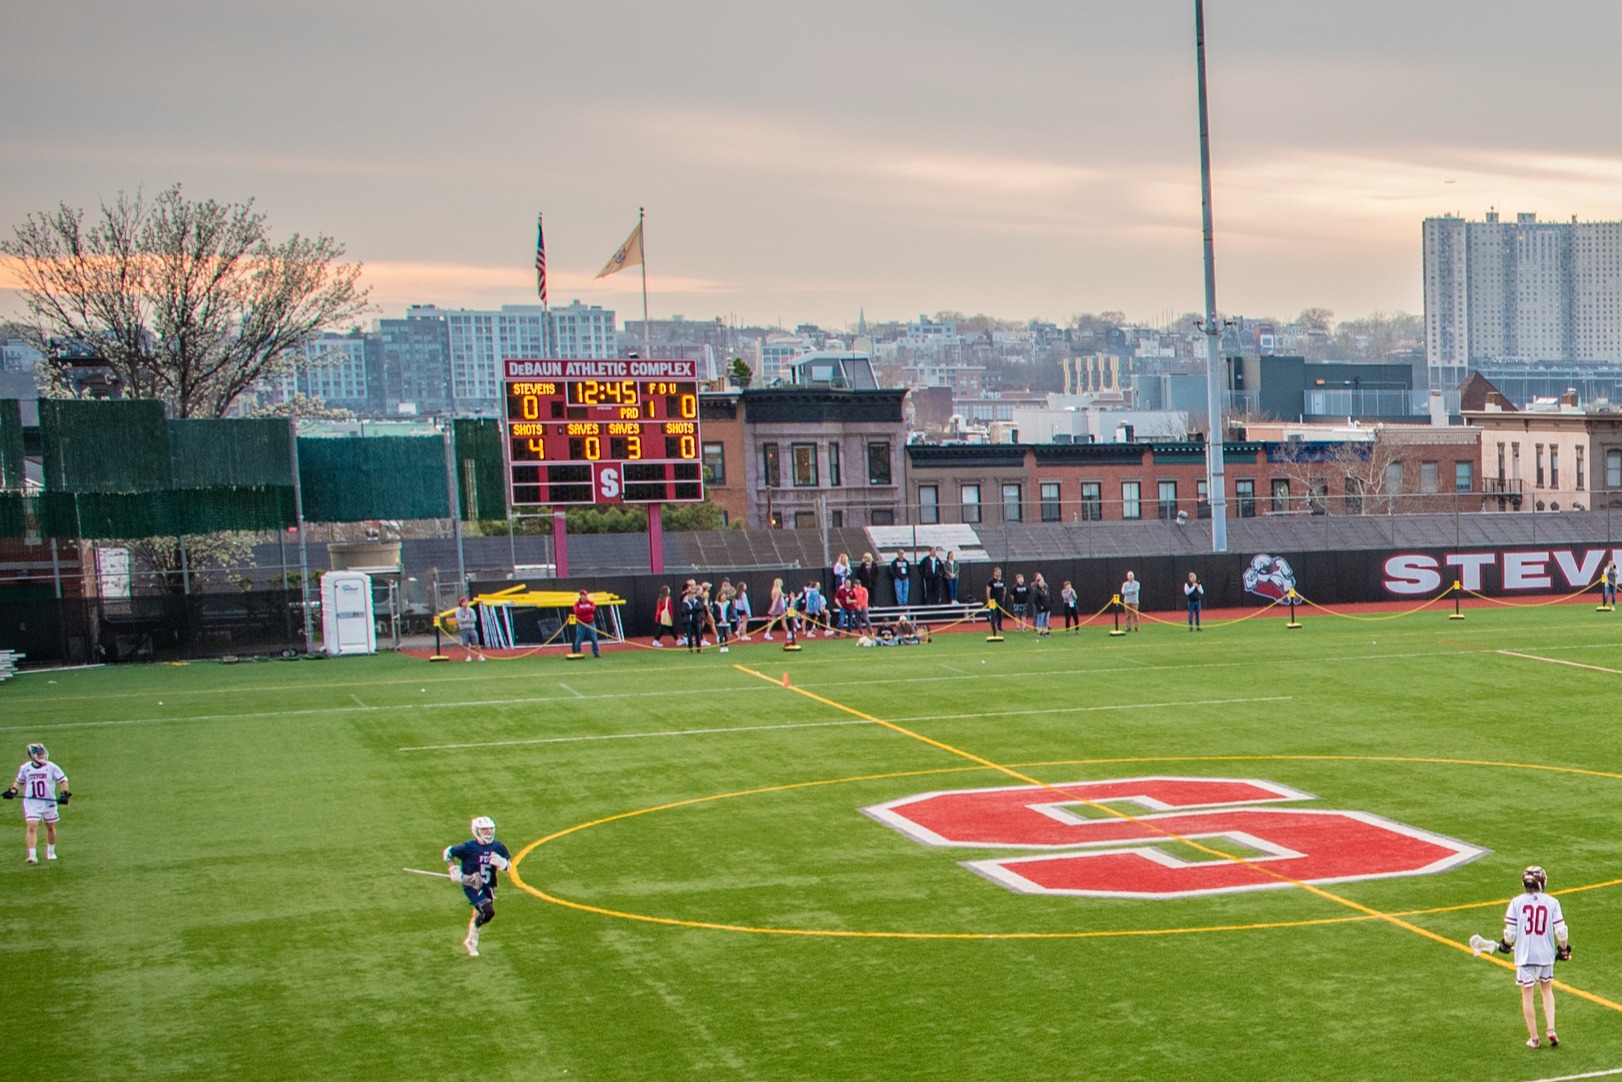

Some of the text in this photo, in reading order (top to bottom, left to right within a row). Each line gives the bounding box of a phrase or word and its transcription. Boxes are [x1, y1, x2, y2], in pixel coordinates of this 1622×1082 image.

[566, 362, 628, 376] ATHLETIC
[630, 362, 692, 376] COMPLEX
[514, 384, 556, 395] STEVENS
[577, 380, 637, 404] 12:45
[523, 396, 538, 420] 0
[620, 407, 638, 419] PRD
[649, 400, 655, 418] 1
[682, 394, 696, 418] 0
[514, 423, 542, 435] SHOTS
[568, 423, 599, 435] SAVES
[609, 423, 640, 434] SAVES
[666, 422, 694, 434] SHOTS
[528, 438, 544, 460] 4
[585, 436, 600, 460] 0
[628, 436, 641, 460] 3
[681, 436, 696, 459] 0
[600, 468, 619, 498] S
[32, 781, 45, 798] 10
[858, 776, 1494, 900] S
[480, 864, 491, 884] 5
[1522, 904, 1548, 935] 30
